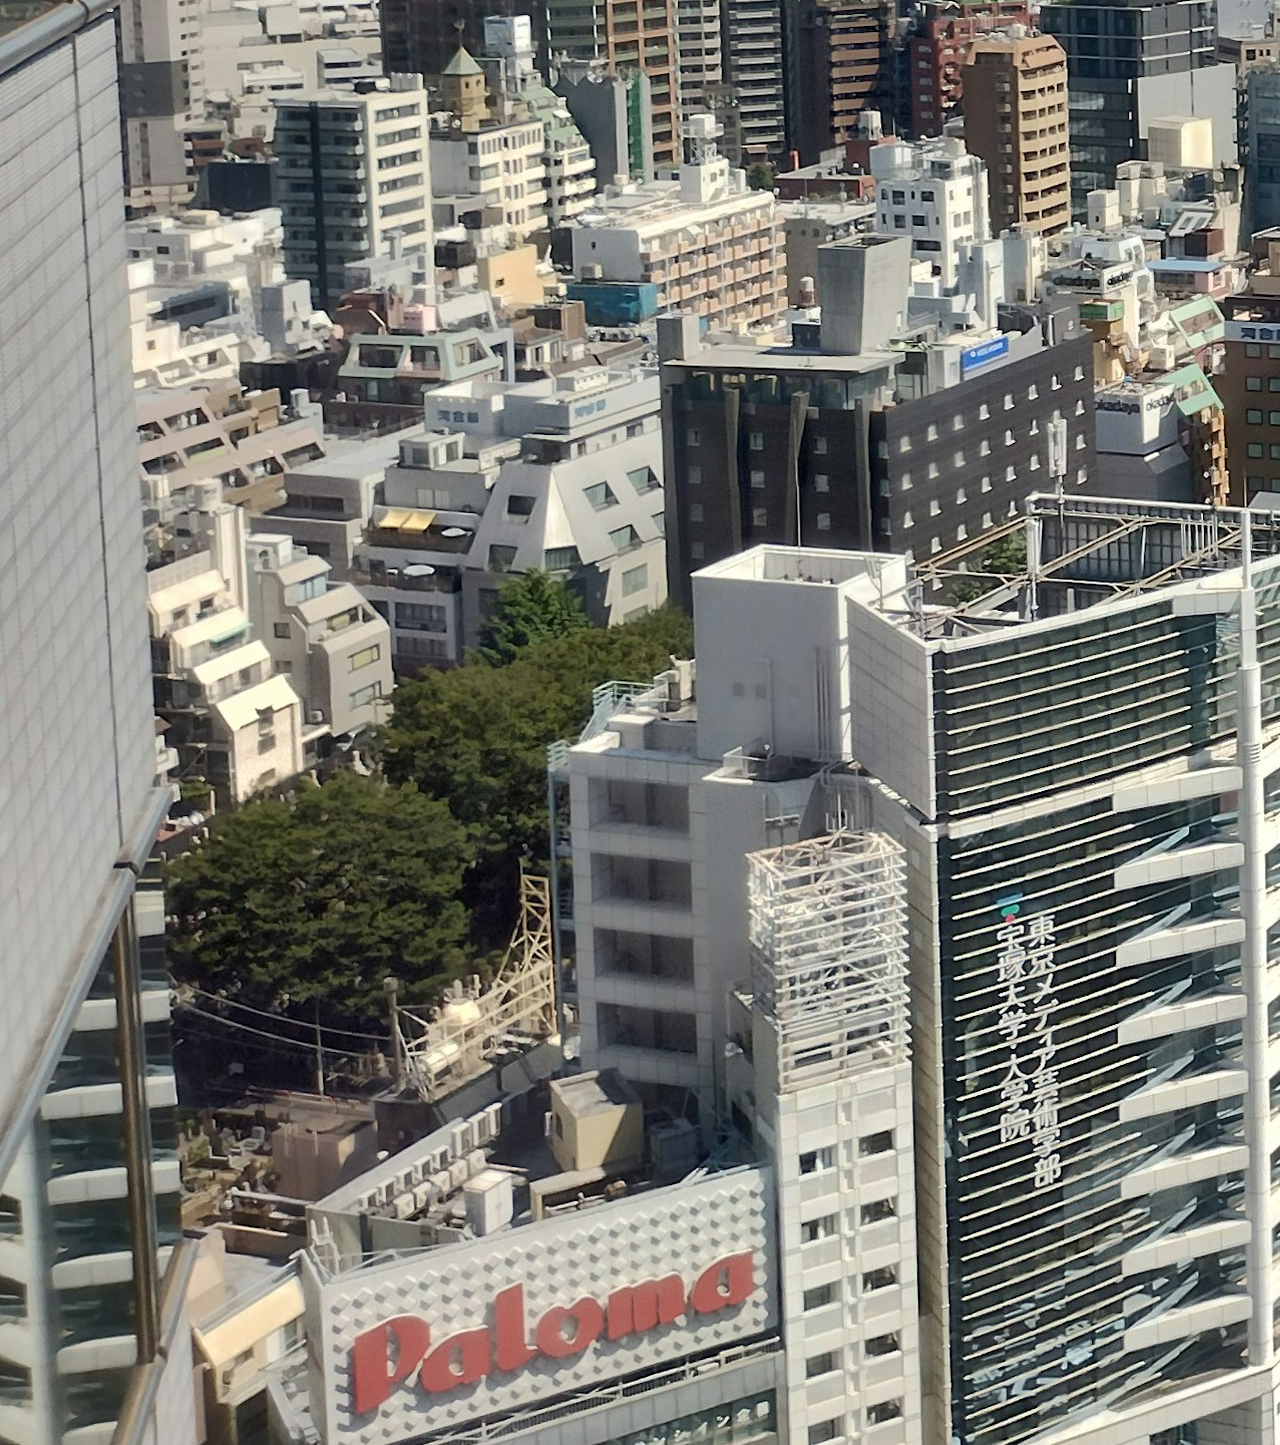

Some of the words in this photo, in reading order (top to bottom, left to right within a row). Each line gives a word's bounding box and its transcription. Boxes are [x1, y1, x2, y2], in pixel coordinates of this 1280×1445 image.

[996, 926, 1030, 1143] 宝塚大学・大学院
[1027, 914, 1062, 1188] 東京メディア芸術学部
[352, 1248, 755, 1415] Paloma
